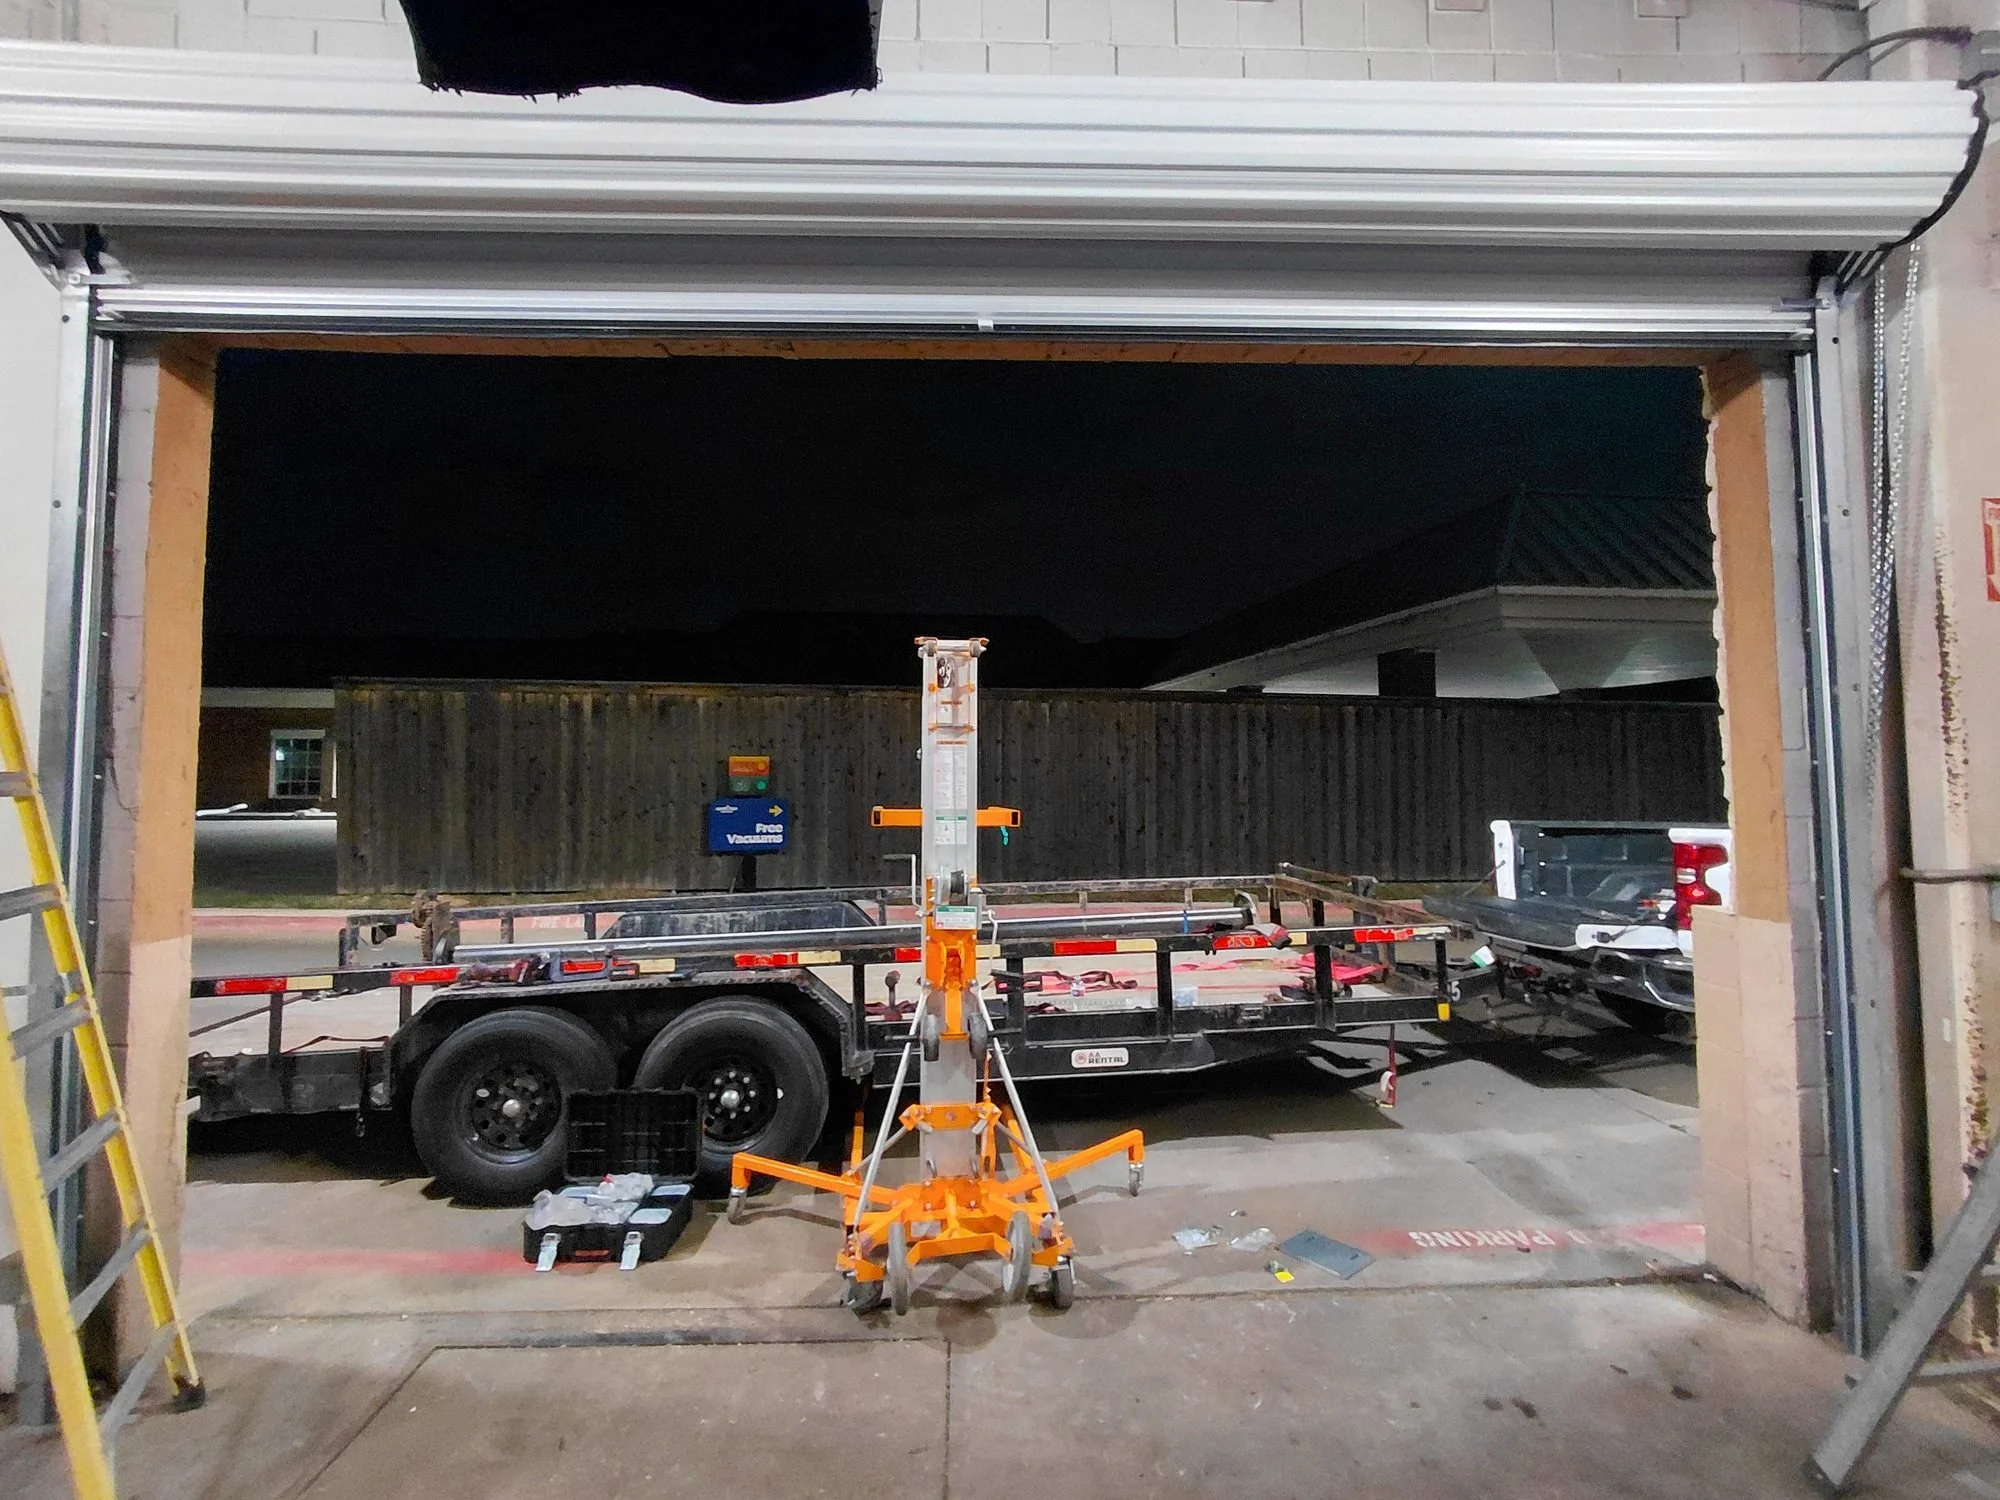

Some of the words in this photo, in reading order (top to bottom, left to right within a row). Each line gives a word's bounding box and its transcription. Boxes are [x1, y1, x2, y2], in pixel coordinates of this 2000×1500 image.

[756, 823, 783, 833] Free
[726, 834, 783, 844] Vacuums
[1088, 1056, 1126, 1065] RENTAL
[1408, 1229, 1556, 1248] PARKING
